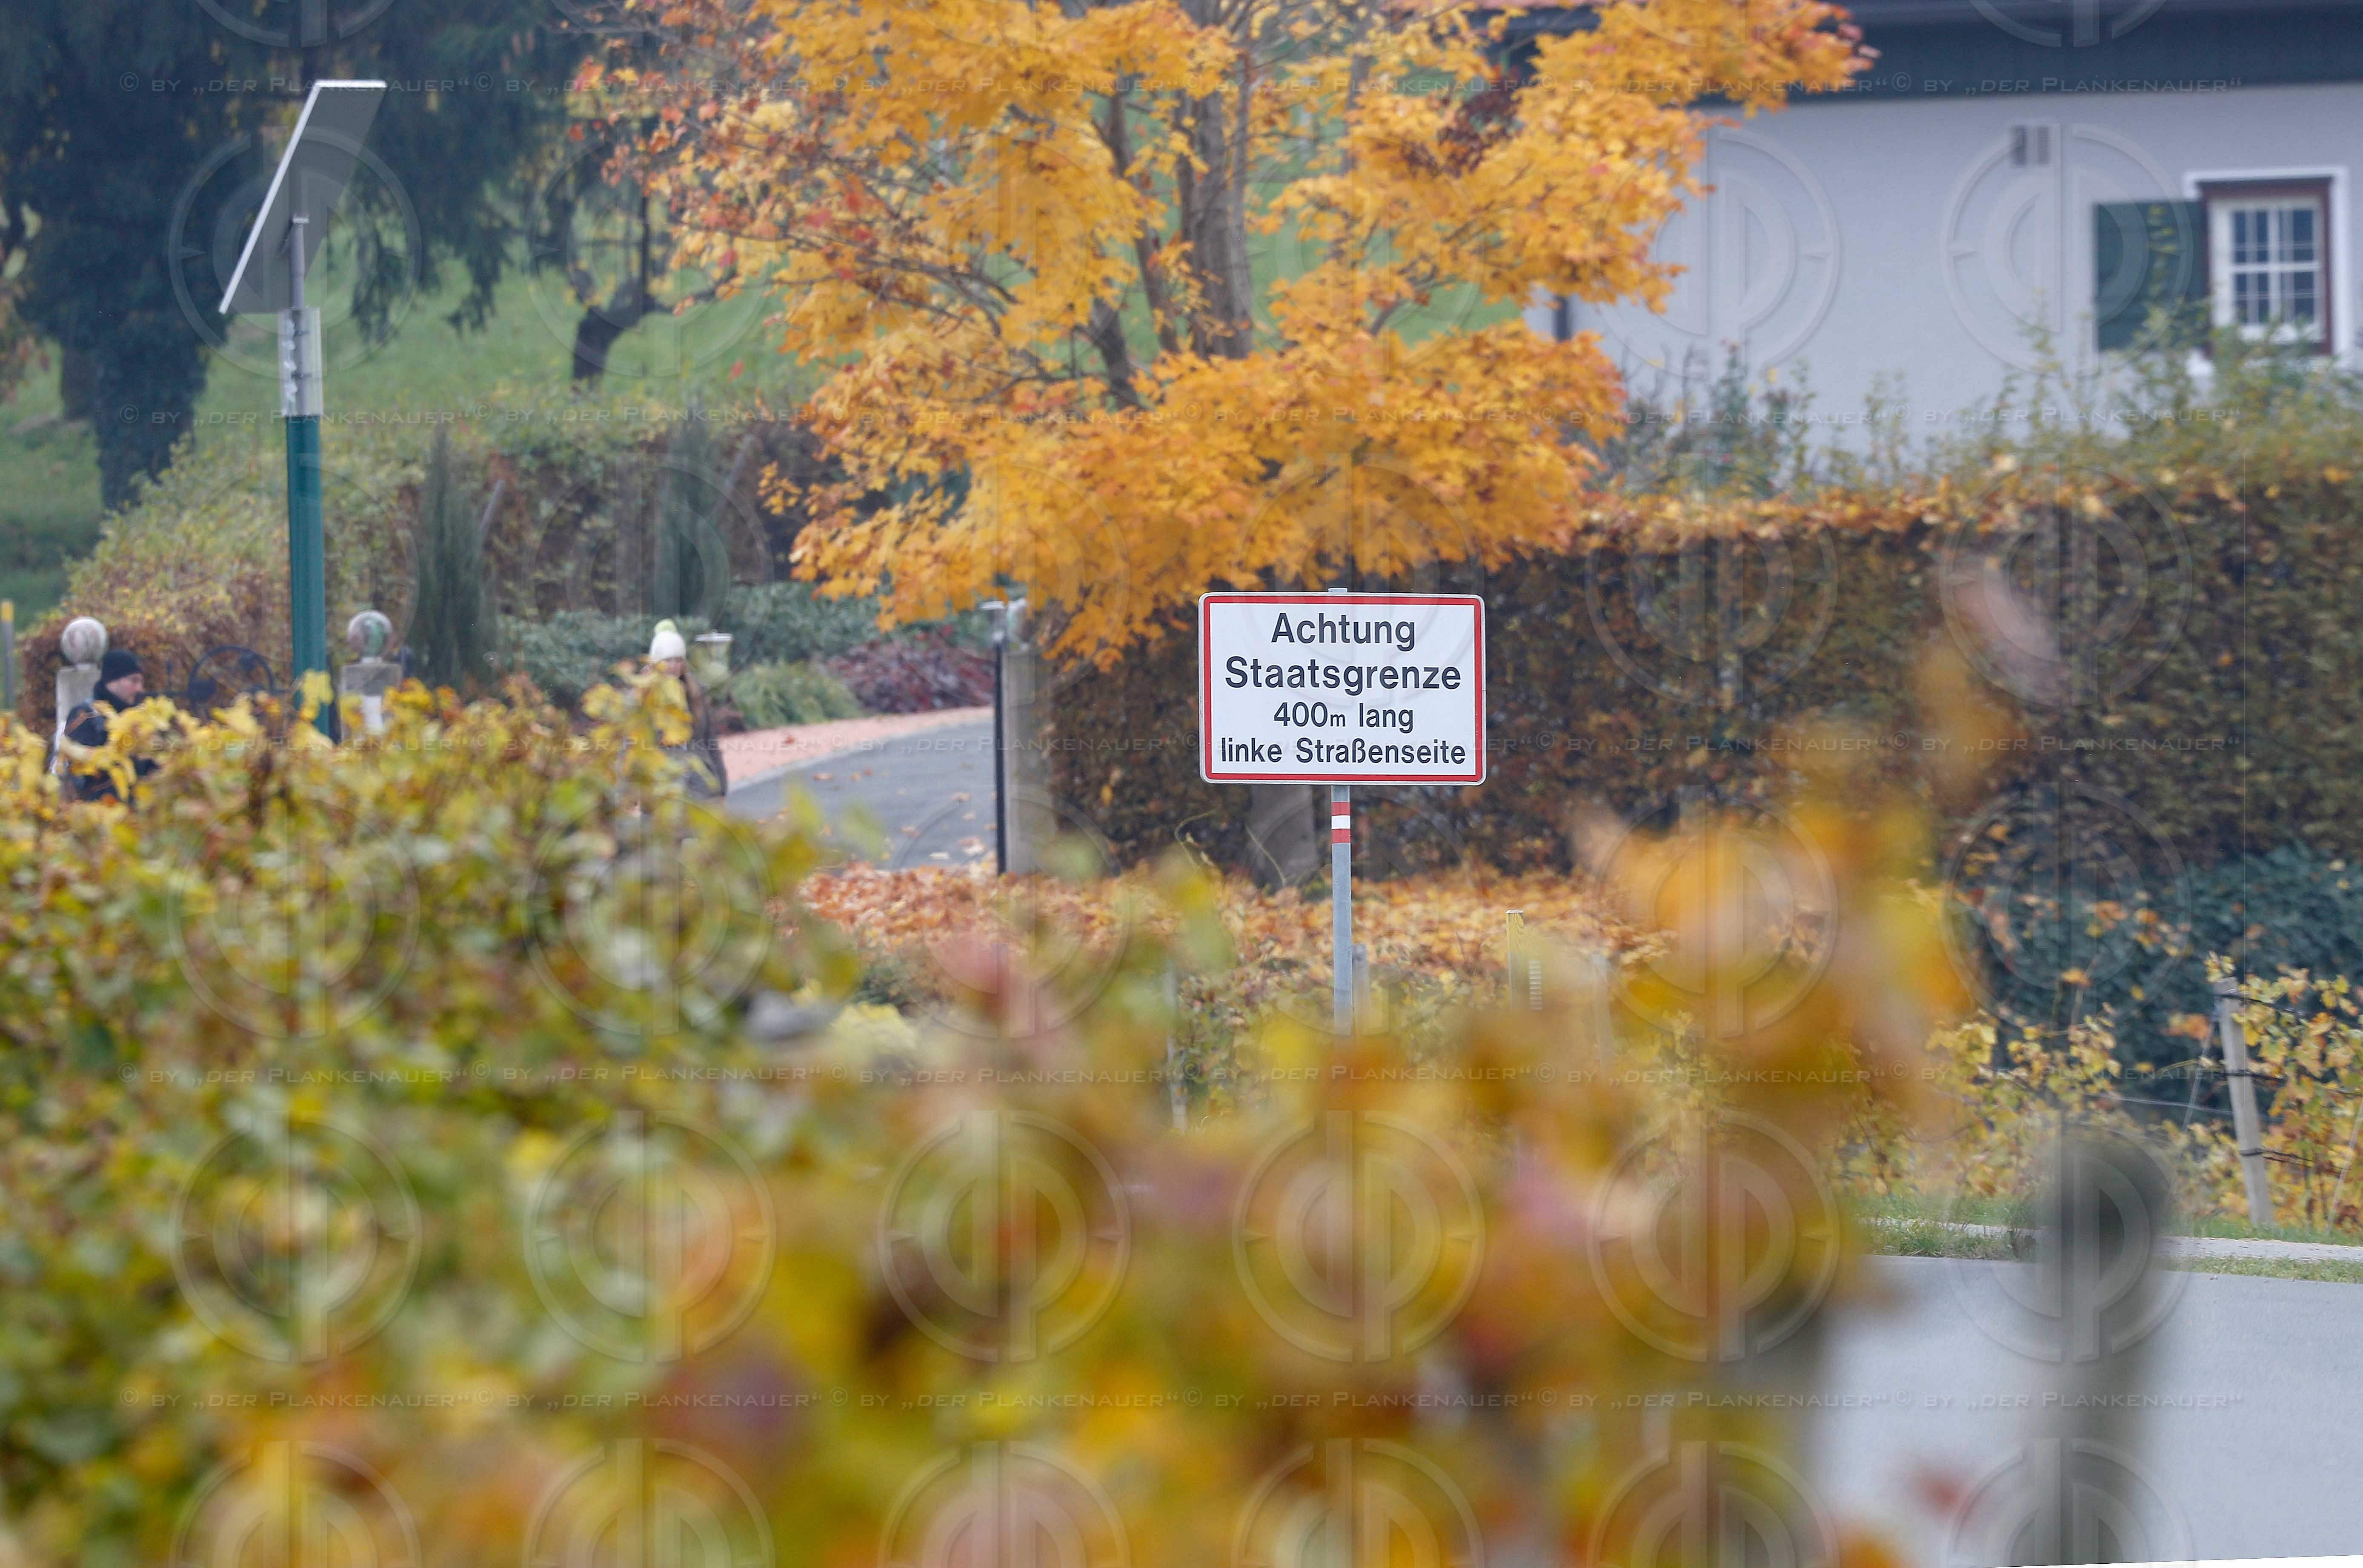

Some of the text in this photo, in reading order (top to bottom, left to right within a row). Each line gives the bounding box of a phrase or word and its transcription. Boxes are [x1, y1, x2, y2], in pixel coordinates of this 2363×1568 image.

[1270, 612, 1415, 652] Achtung
[1225, 656, 1461, 696] Staatsgrenze
[1273, 702, 1413, 734] 400m lang
[1221, 737, 1282, 762] linke
[1296, 737, 1466, 764] Straßenseite
